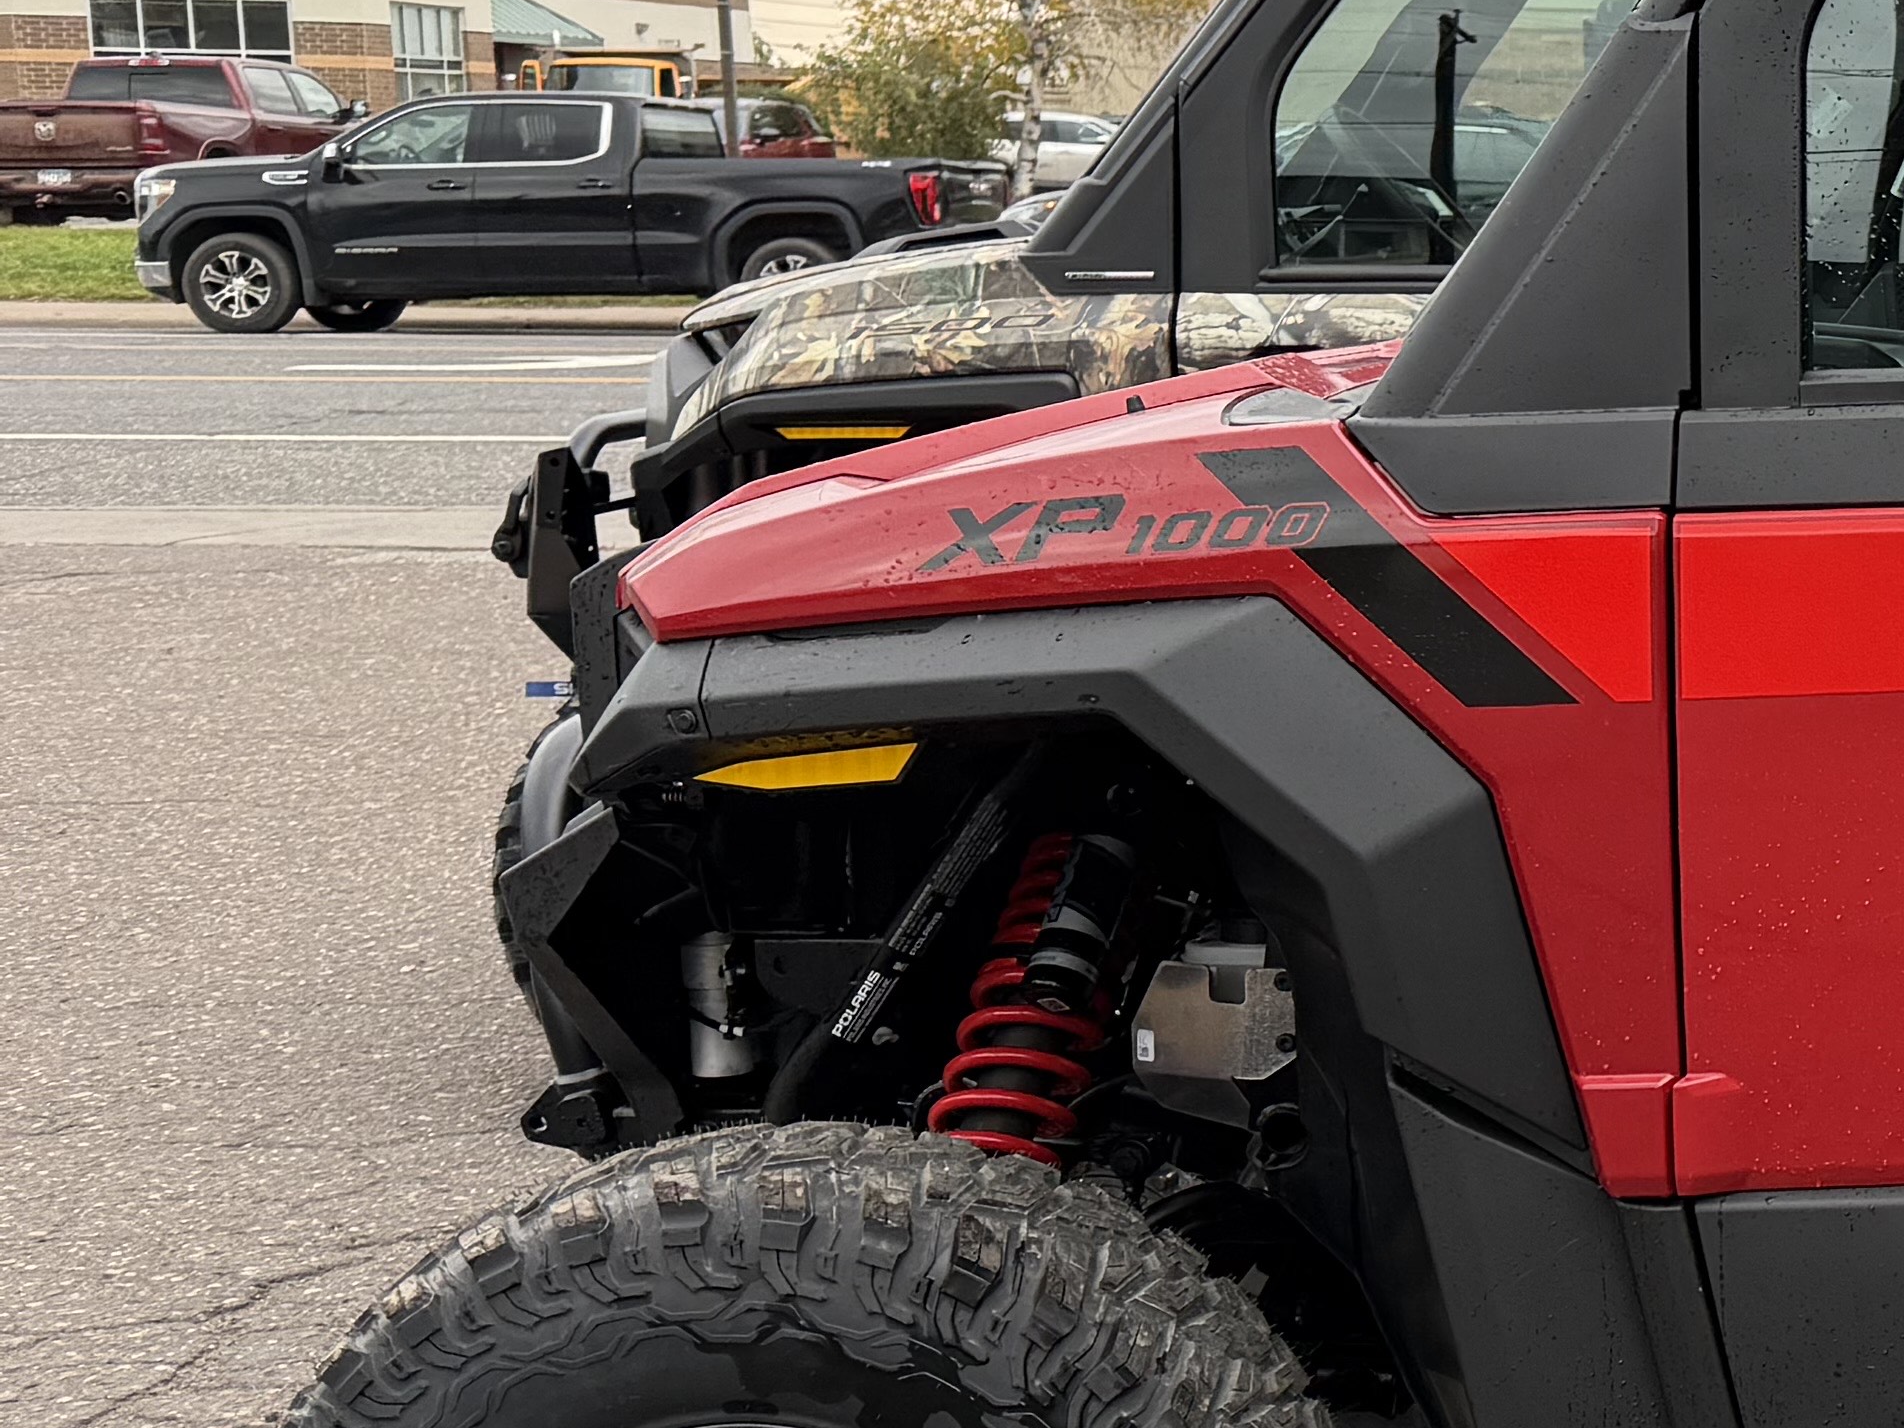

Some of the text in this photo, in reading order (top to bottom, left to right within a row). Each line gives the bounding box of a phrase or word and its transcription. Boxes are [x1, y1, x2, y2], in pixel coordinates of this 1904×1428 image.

[916, 494, 1331, 572] XP 1000
[830, 969, 882, 1039] POLARIS
